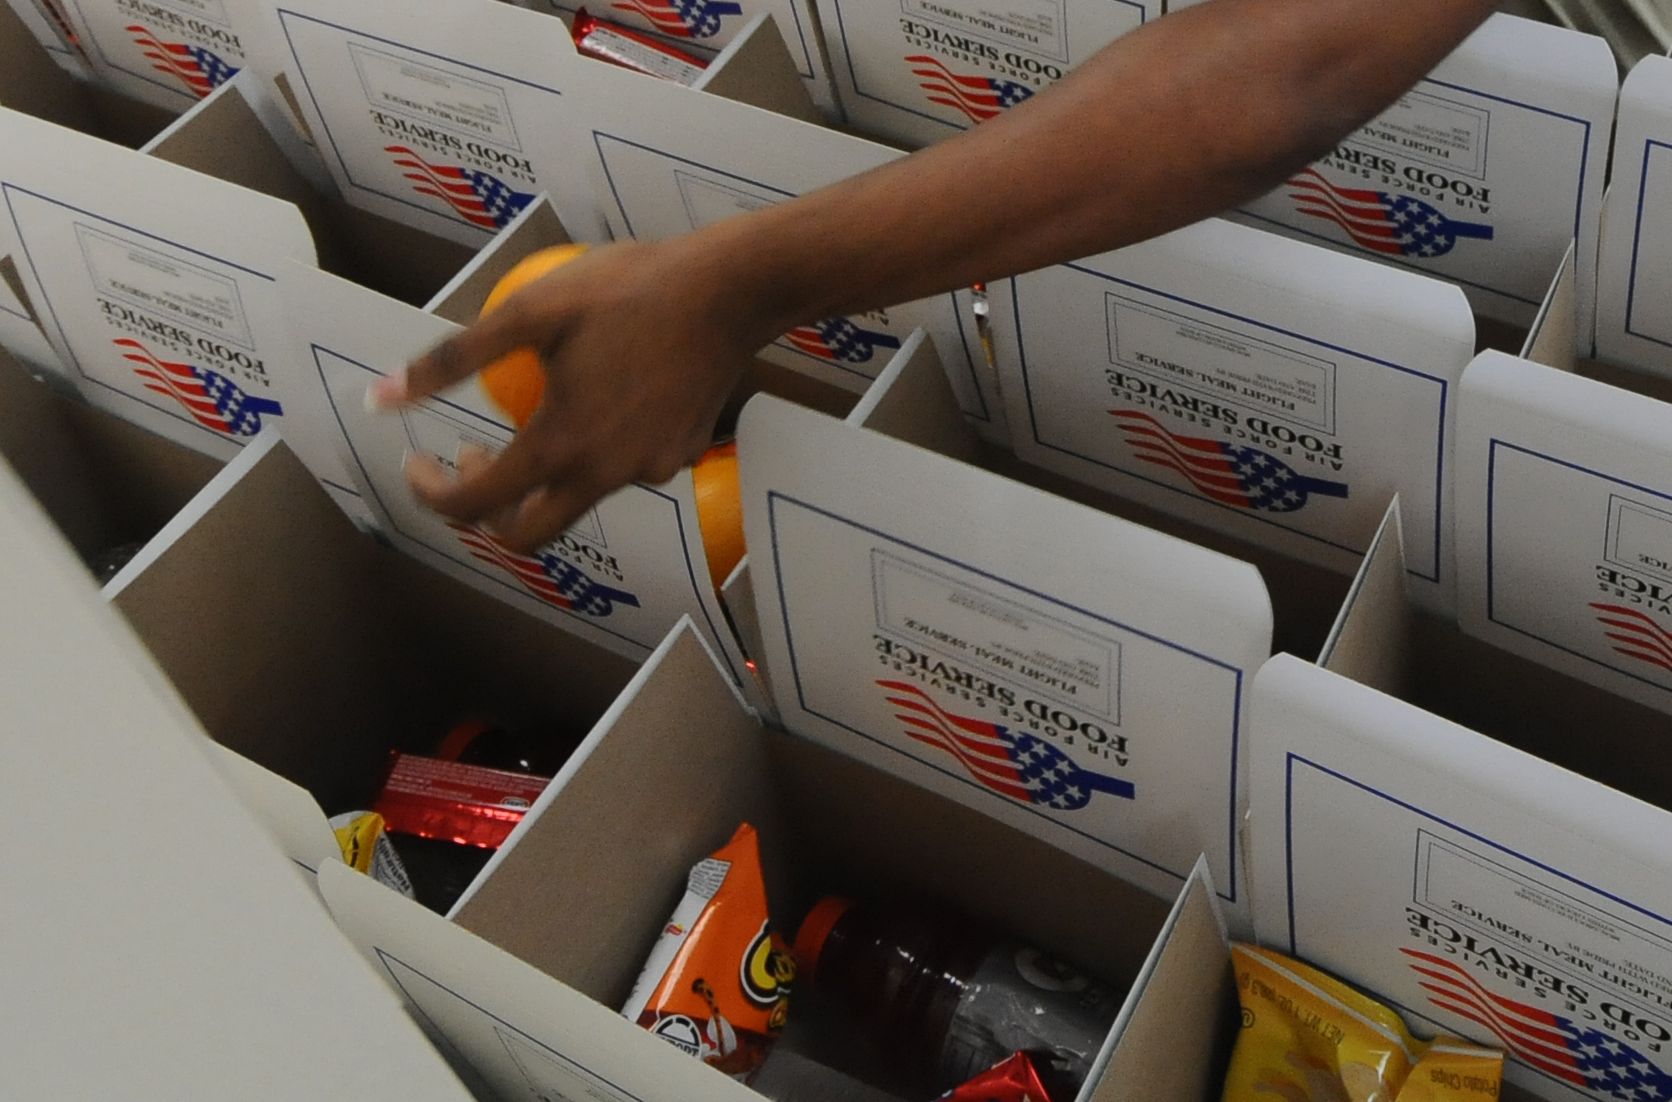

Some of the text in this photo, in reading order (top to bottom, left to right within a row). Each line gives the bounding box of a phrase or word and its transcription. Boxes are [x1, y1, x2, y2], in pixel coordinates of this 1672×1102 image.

[899, 19, 1061, 80] OOD SERVICE
[905, 36, 1041, 85] FORCE SERVICES
[370, 110, 464, 152] SERVICE
[1362, 127, 1449, 158] FLIGHT MEAL
[377, 126, 539, 186] AIR FORCE SERVICES
[465, 141, 535, 175] FOOD
[1330, 147, 1490, 203] FOOD SERV
[1322, 158, 1490, 214] AIR FORCE SERV
[97, 298, 195, 348] SERVICE
[195, 336, 269, 377] FOOD
[1136, 352, 1194, 379] SERVICE
[1106, 369, 1239, 426] SERVICE
[1197, 372, 1237, 393] MEAL
[1241, 386, 1295, 412] FLIGHT
[1110, 386, 1211, 428] SERVICES
[1223, 424, 1292, 455] FORCE
[1246, 415, 1344, 462] FOOD
[1305, 452, 1343, 473] AIR
[558, 536, 620, 570] FOO
[592, 562, 623, 582] AIR
[874, 634, 1016, 709] SERVICE
[878, 654, 986, 709] SERVICES
[999, 705, 1074, 746] FORCE
[1024, 696, 1130, 756] FOOD
[1088, 743, 1129, 769] AIR
[1452, 900, 1533, 945] SERVICE
[1406, 907, 1589, 1007] SERVICE
[1409, 925, 1547, 999] SERVICES
[1538, 939, 1594, 973] MEAL
[1322, 1022, 1346, 1045] NET
[1564, 1000, 1661, 1053] FORCE
[1431, 1069, 1497, 1097] Potato Chips
